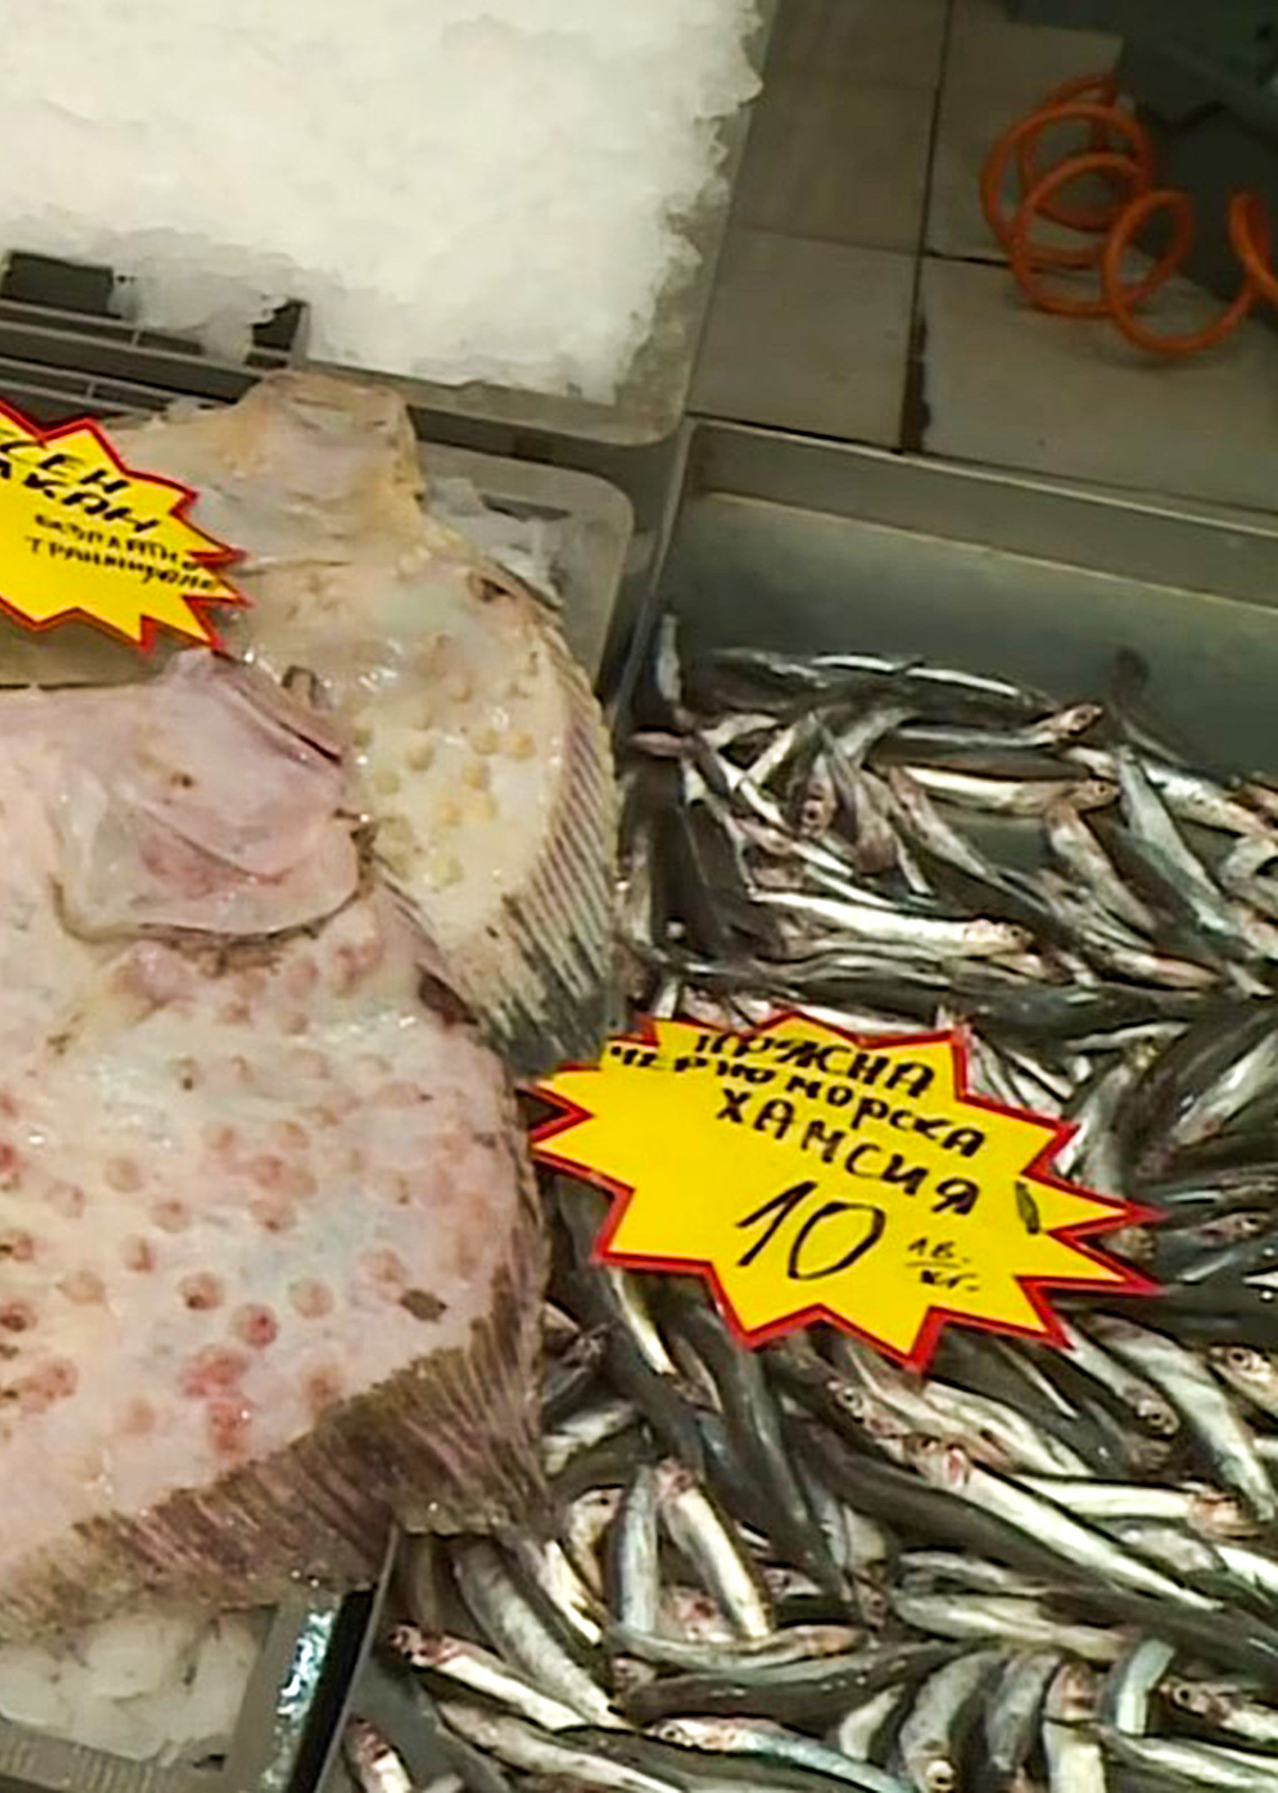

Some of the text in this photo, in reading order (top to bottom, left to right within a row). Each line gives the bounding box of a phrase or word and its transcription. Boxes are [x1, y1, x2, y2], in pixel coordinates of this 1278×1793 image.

[694, 1034, 935, 1098] ПРЯСНА
[715, 1087, 981, 1216] ХАМСИЯ
[734, 1181, 887, 1281] 10
